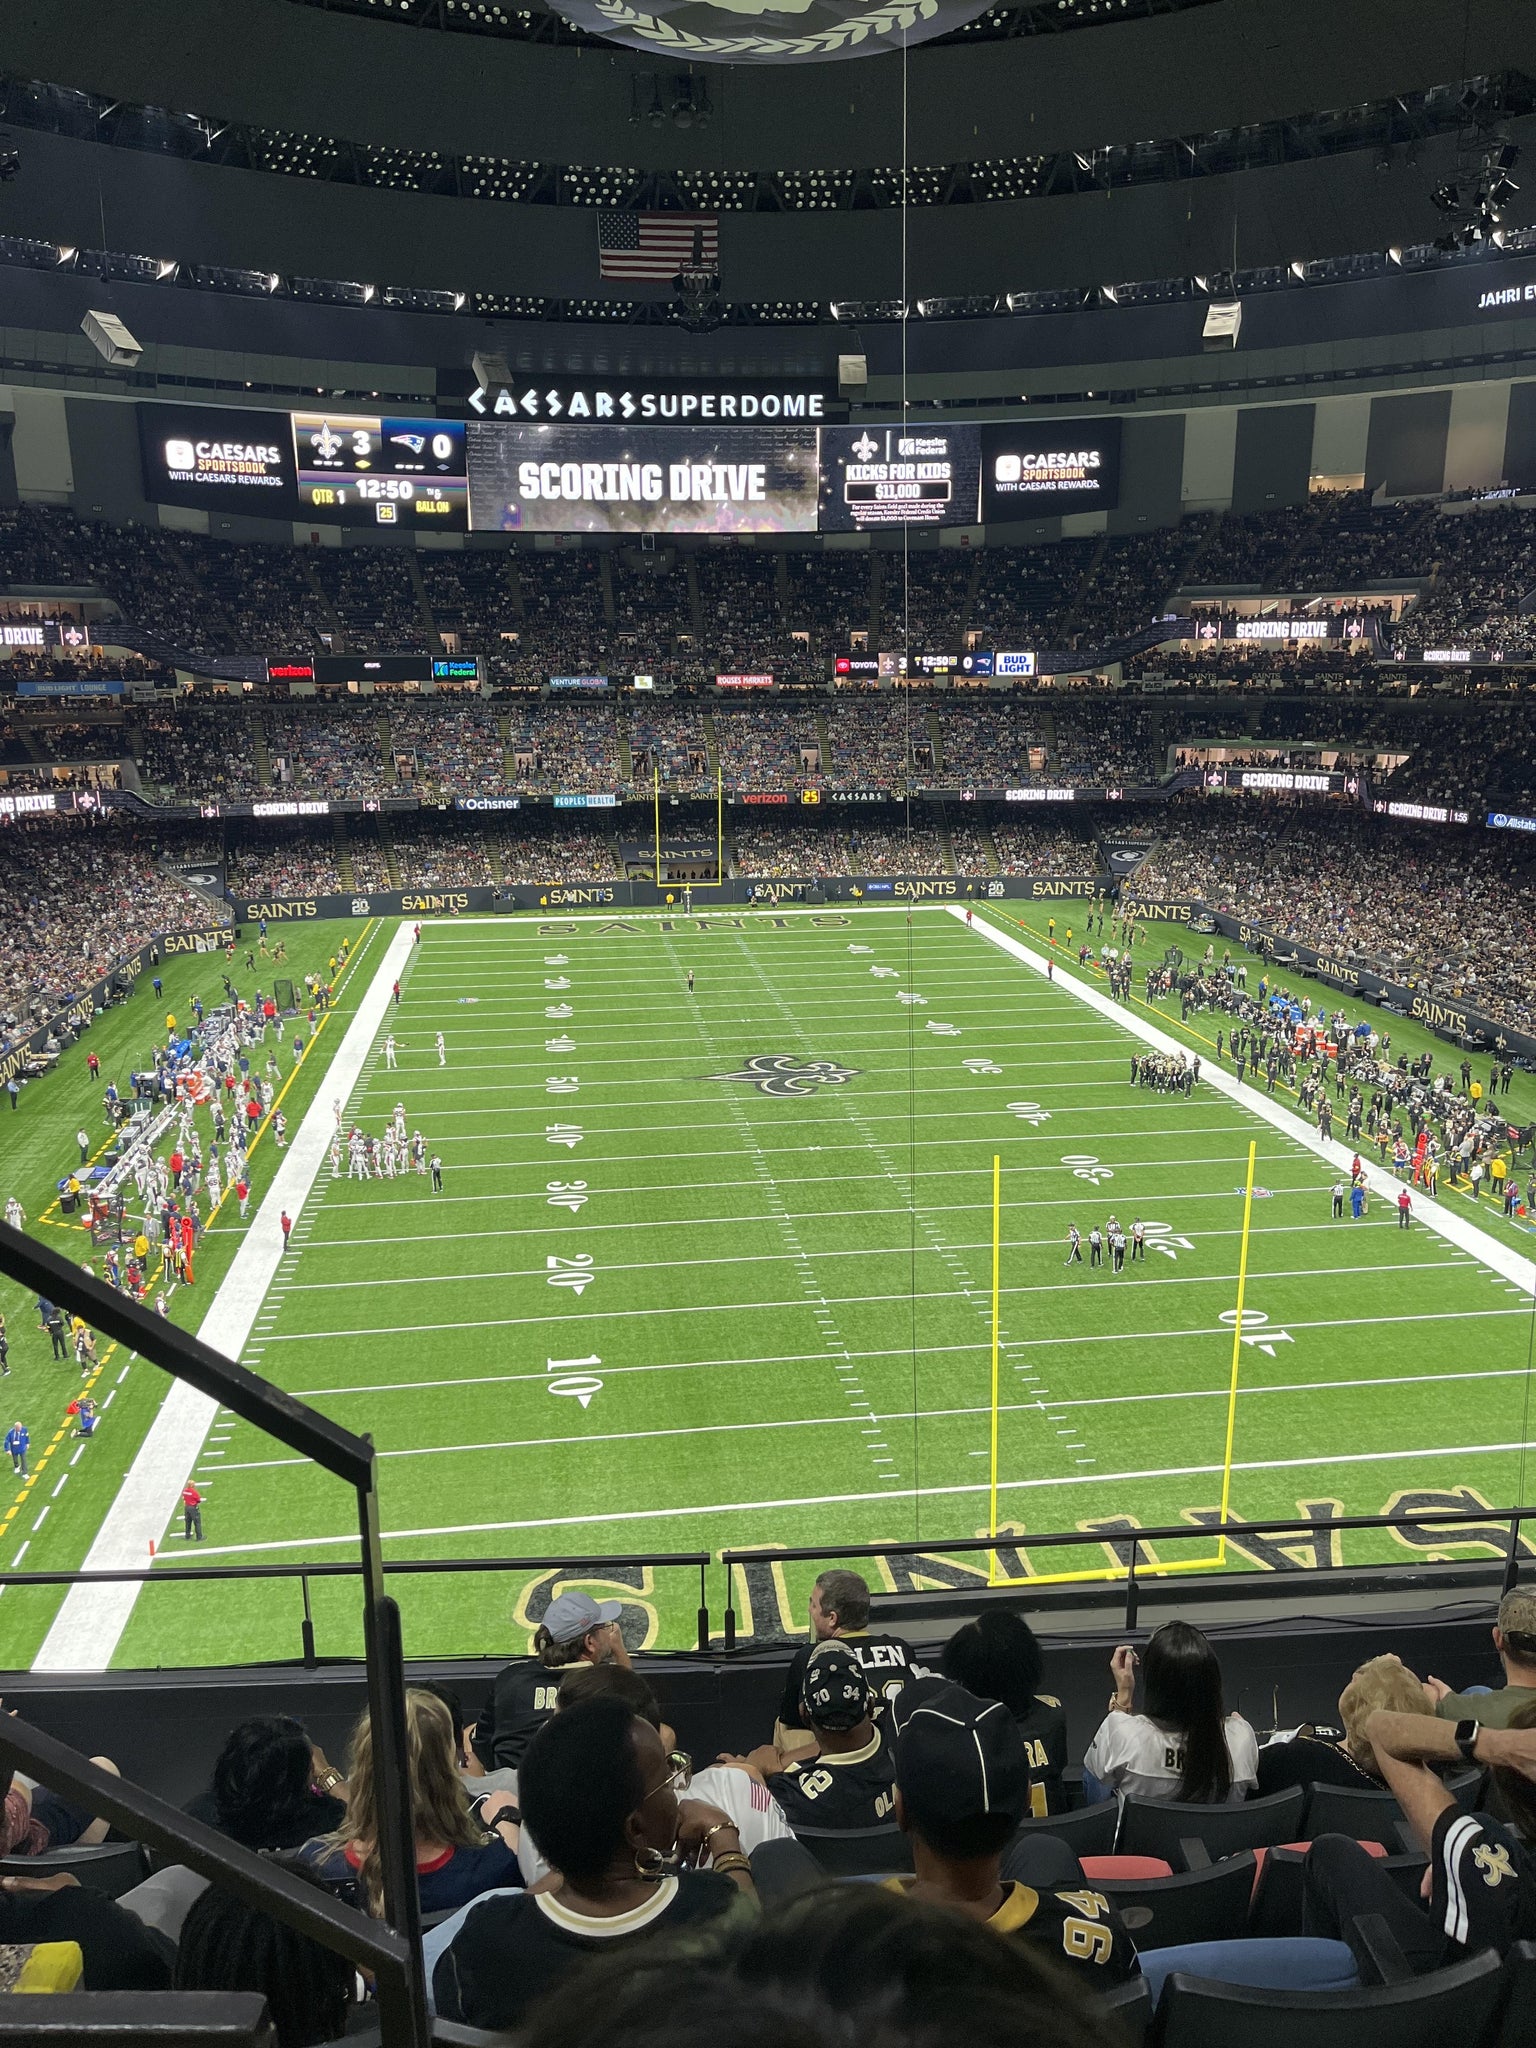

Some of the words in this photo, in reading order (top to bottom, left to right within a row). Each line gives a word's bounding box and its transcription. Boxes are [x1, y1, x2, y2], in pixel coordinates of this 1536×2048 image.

[1478, 288, 1520, 308] JAHRI
[467, 388, 640, 418] CAESARS
[641, 394, 824, 417] SUPERDOME
[352, 431, 371, 455] 3
[432, 434, 452, 459] 0
[915, 446, 947, 455] Federal
[196, 442, 280, 464] CAESARS
[1022, 451, 1100, 469] CAESARS
[198, 459, 267, 474] SPORTSBOOK
[846, 464, 888, 480] KICKS
[889, 464, 915, 480] FOR
[917, 463, 951, 479] KIDS
[1023, 468, 1086, 480] SPORTSBOOK
[168, 470, 194, 482] WITH
[195, 472, 237, 485] CAESARS
[518, 462, 664, 500] SCORING
[669, 463, 766, 500] DRIVE
[356, 479, 413, 500] 12:50
[875, 483, 921, 500] $11,000
[995, 483, 1018, 492] WITH
[1019, 481, 1057, 491] CAESARS
[312, 489, 334, 505] QTR
[337, 490, 346, 504] 1
[380, 507, 393, 519] 25
[416, 501, 436, 512] BALL
[436, 502, 450, 513] ON
[4, 628, 44, 645] DRIVE
[1236, 621, 1289, 638] SCORING
[1290, 621, 1327, 638] DRIVE
[921, 656, 948, 667] 12:50
[963, 656, 973, 669] 0
[1003, 655, 1027, 664] BUD
[1423, 651, 1450, 661] SCORING
[1450, 651, 1470, 661] DRIVE
[270, 665, 312, 678] verizon
[449, 661, 476, 669] Keesler
[850, 661, 878, 669] TOYOTA
[999, 664, 1031, 673] LIGHT
[515, 676, 543, 684] SAINTS
[681, 675, 707, 683] SAINTS
[1252, 672, 1281, 680] SAINTS
[1315, 672, 1344, 680] SAINTS
[1378, 672, 1407, 680] SAINTS
[1443, 674, 1470, 682] SAINTS
[80, 684, 107, 692] LOUNGE
[1242, 772, 1292, 789] SCORING
[1293, 775, 1330, 790] DRIVE
[555, 796, 586, 806] PEOPLES
[587, 795, 615, 806] HEALTH
[626, 793, 655, 801] SAINTS
[690, 792, 719, 800] SAINTS
[742, 792, 787, 804] verizon
[803, 791, 818, 802] 25
[831, 792, 882, 801] CAESARS
[891, 789, 919, 798] SAINTS
[1005, 789, 1046, 800] SCORING
[1046, 789, 1075, 800] DRIVE
[15, 794, 56, 811] DRIVE
[253, 802, 298, 816] SCORING
[299, 801, 329, 815] DRIVE
[421, 797, 451, 806] SAINTS
[467, 797, 519, 810] Ochsner
[1388, 802, 1423, 818] SCORING
[1422, 807, 1448, 821] DRIVE
[1506, 817, 1536, 831] Allstate
[638, 849, 714, 859] SAINTS
[551, 887, 614, 904] SAINTS
[894, 881, 956, 896] SAINTS
[1033, 881, 1095, 896] SAINTS
[401, 893, 468, 911] SAINTS
[247, 901, 317, 919] SAINTS
[536, 916, 852, 936] SAINTS
[164, 929, 233, 953] SAINTS
[1317, 957, 1359, 984] SAINTS
[1412, 997, 1467, 1034] SAINTS
[1006, 1101, 1053, 1121] 40
[546, 1122, 584, 1144] 40
[1060, 1154, 1114, 1179] 30
[546, 1180, 589, 1206] 30
[1128, 1221, 1196, 1253] 20
[546, 1253, 595, 1287] 20
[1218, 1309, 1295, 1346] 10
[547, 1354, 604, 1396] 10
[534, 1687, 560, 1710] BR
[812, 1688, 831, 1707] 70
[842, 1685, 860, 1700] 34
[1056, 1889, 1114, 1965] 94
